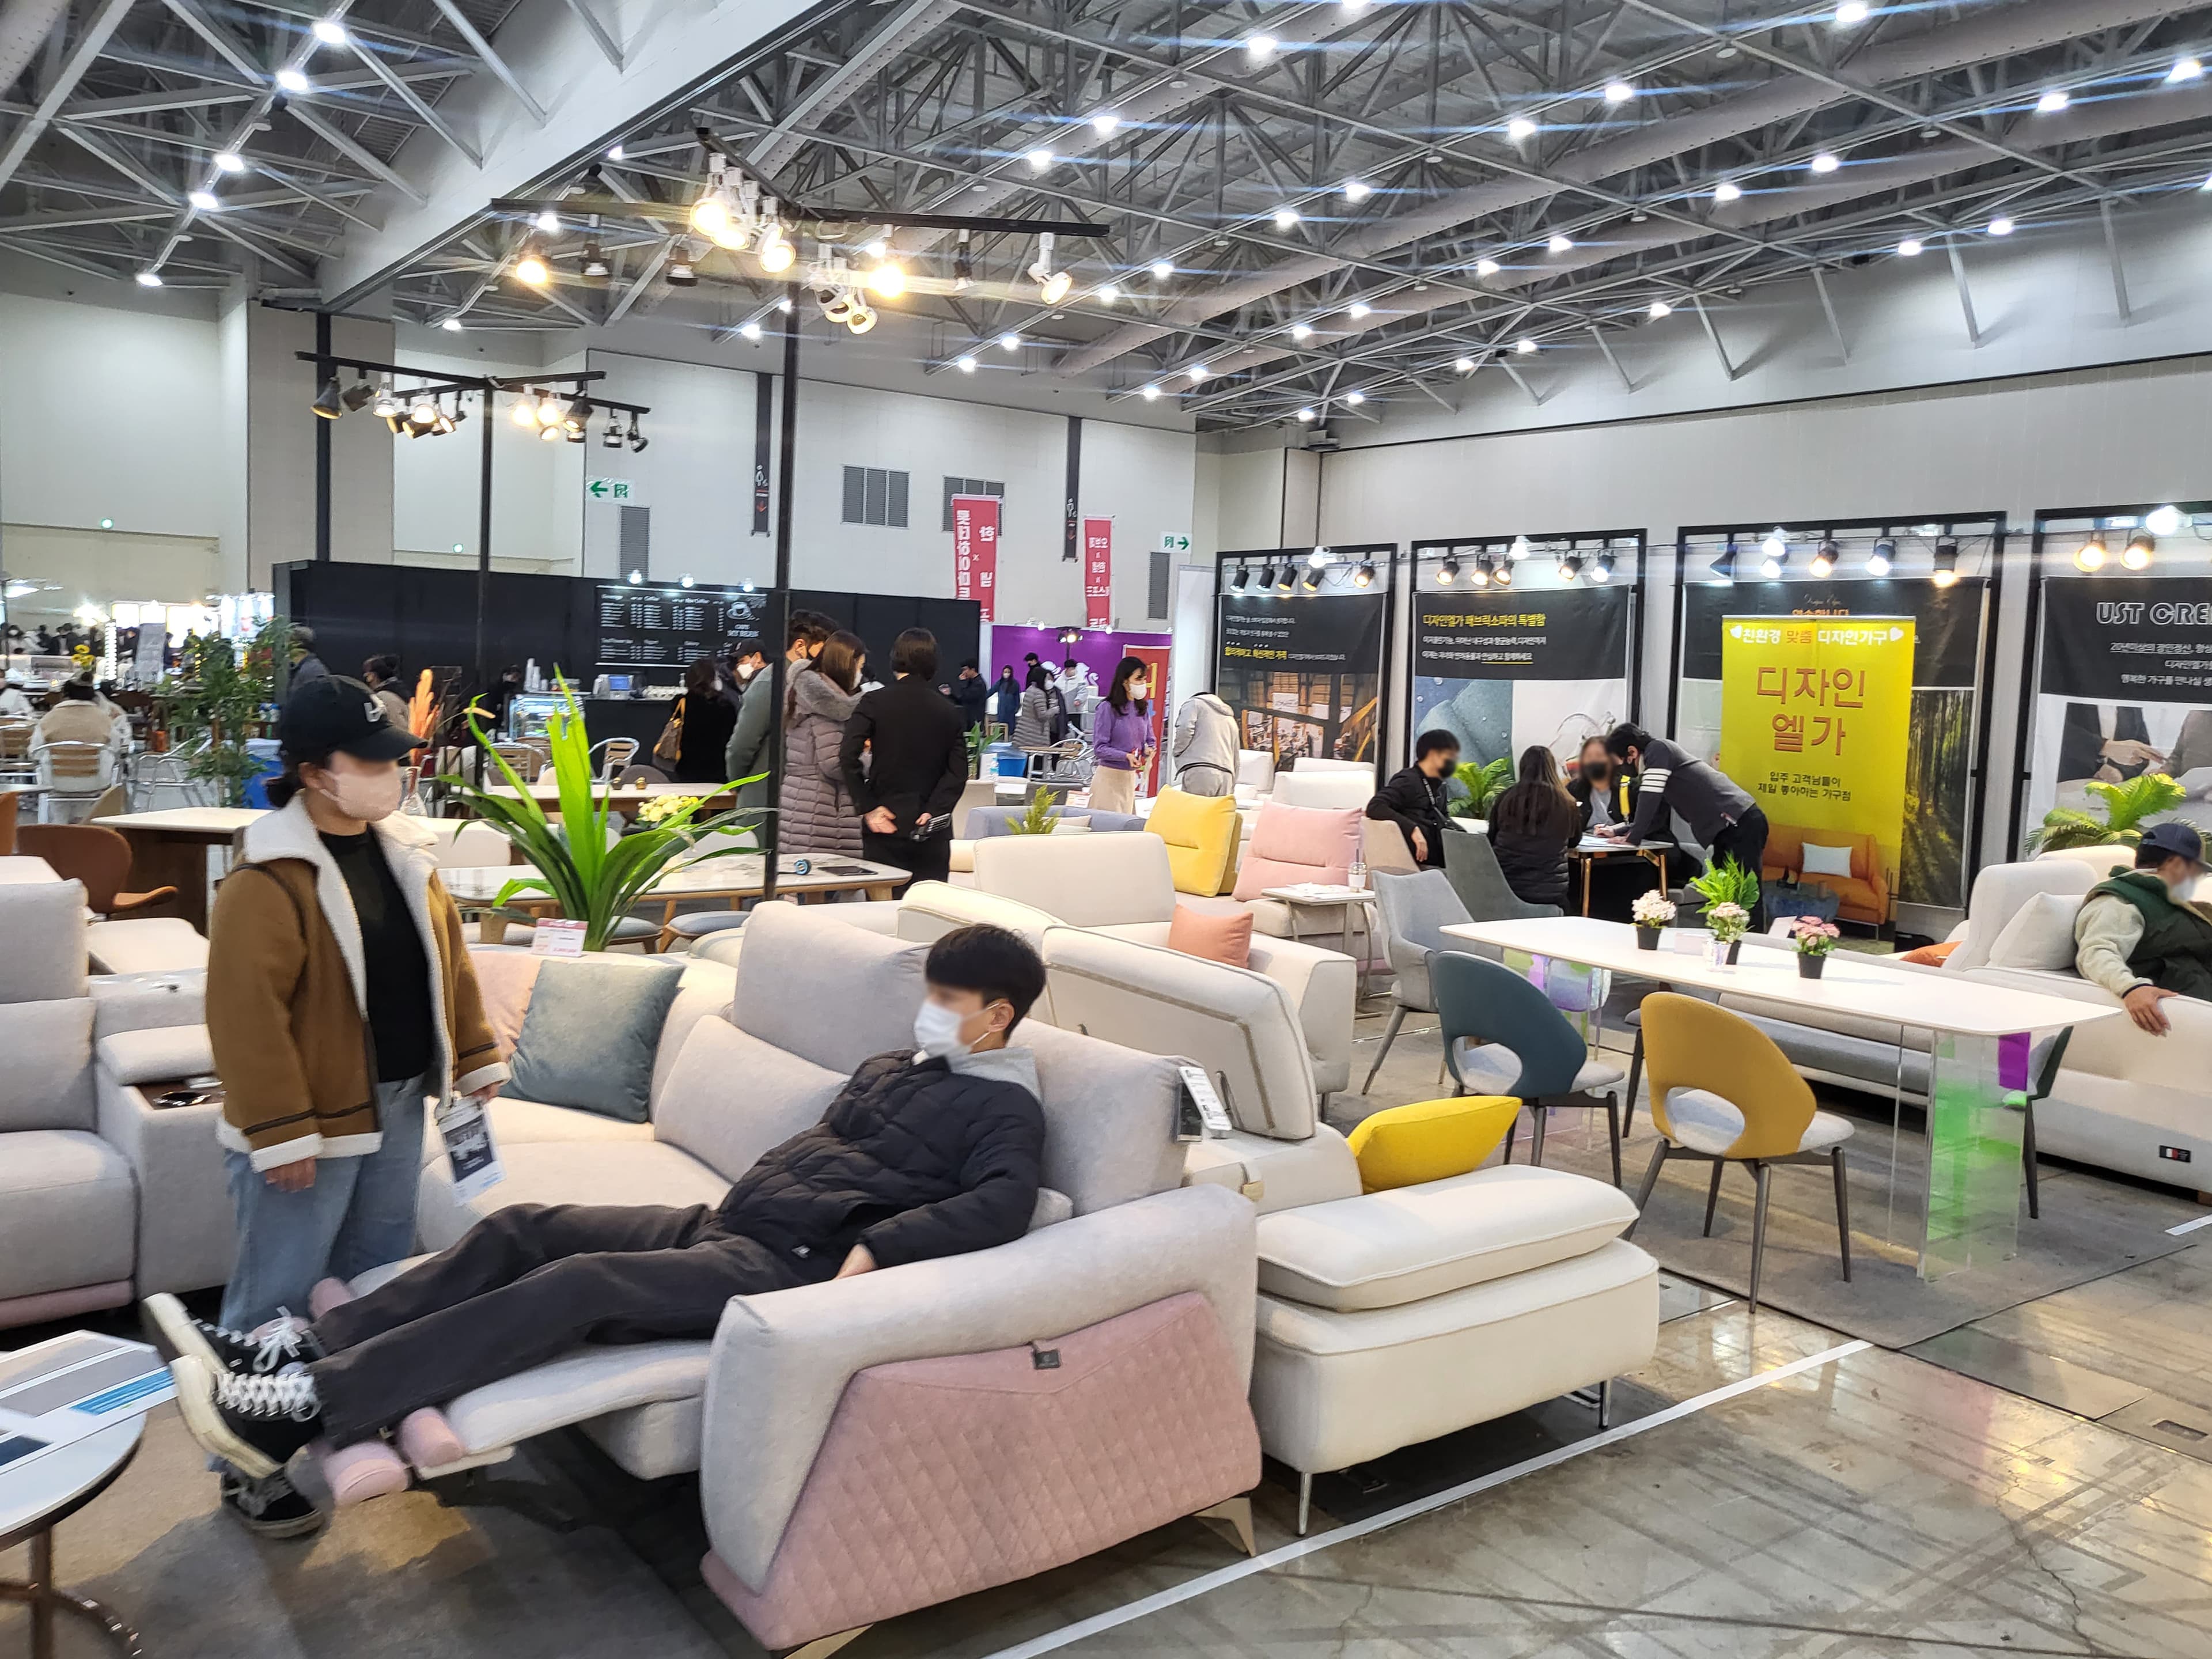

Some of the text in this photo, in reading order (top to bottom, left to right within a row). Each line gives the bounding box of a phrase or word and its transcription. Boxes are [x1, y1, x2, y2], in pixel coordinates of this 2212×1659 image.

[1518, 613, 1546, 627] 특별함
[2096, 601, 2212, 625] UST CRE
[1743, 628, 1887, 646] 친환경 맞춤 디자인가구
[1757, 667, 1865, 709] 디자인
[1772, 714, 1846, 756] 엘가
[1770, 771, 1840, 787] 입주 고객님들이
[1758, 783, 1851, 802] 제일 좋아하는 가구점
